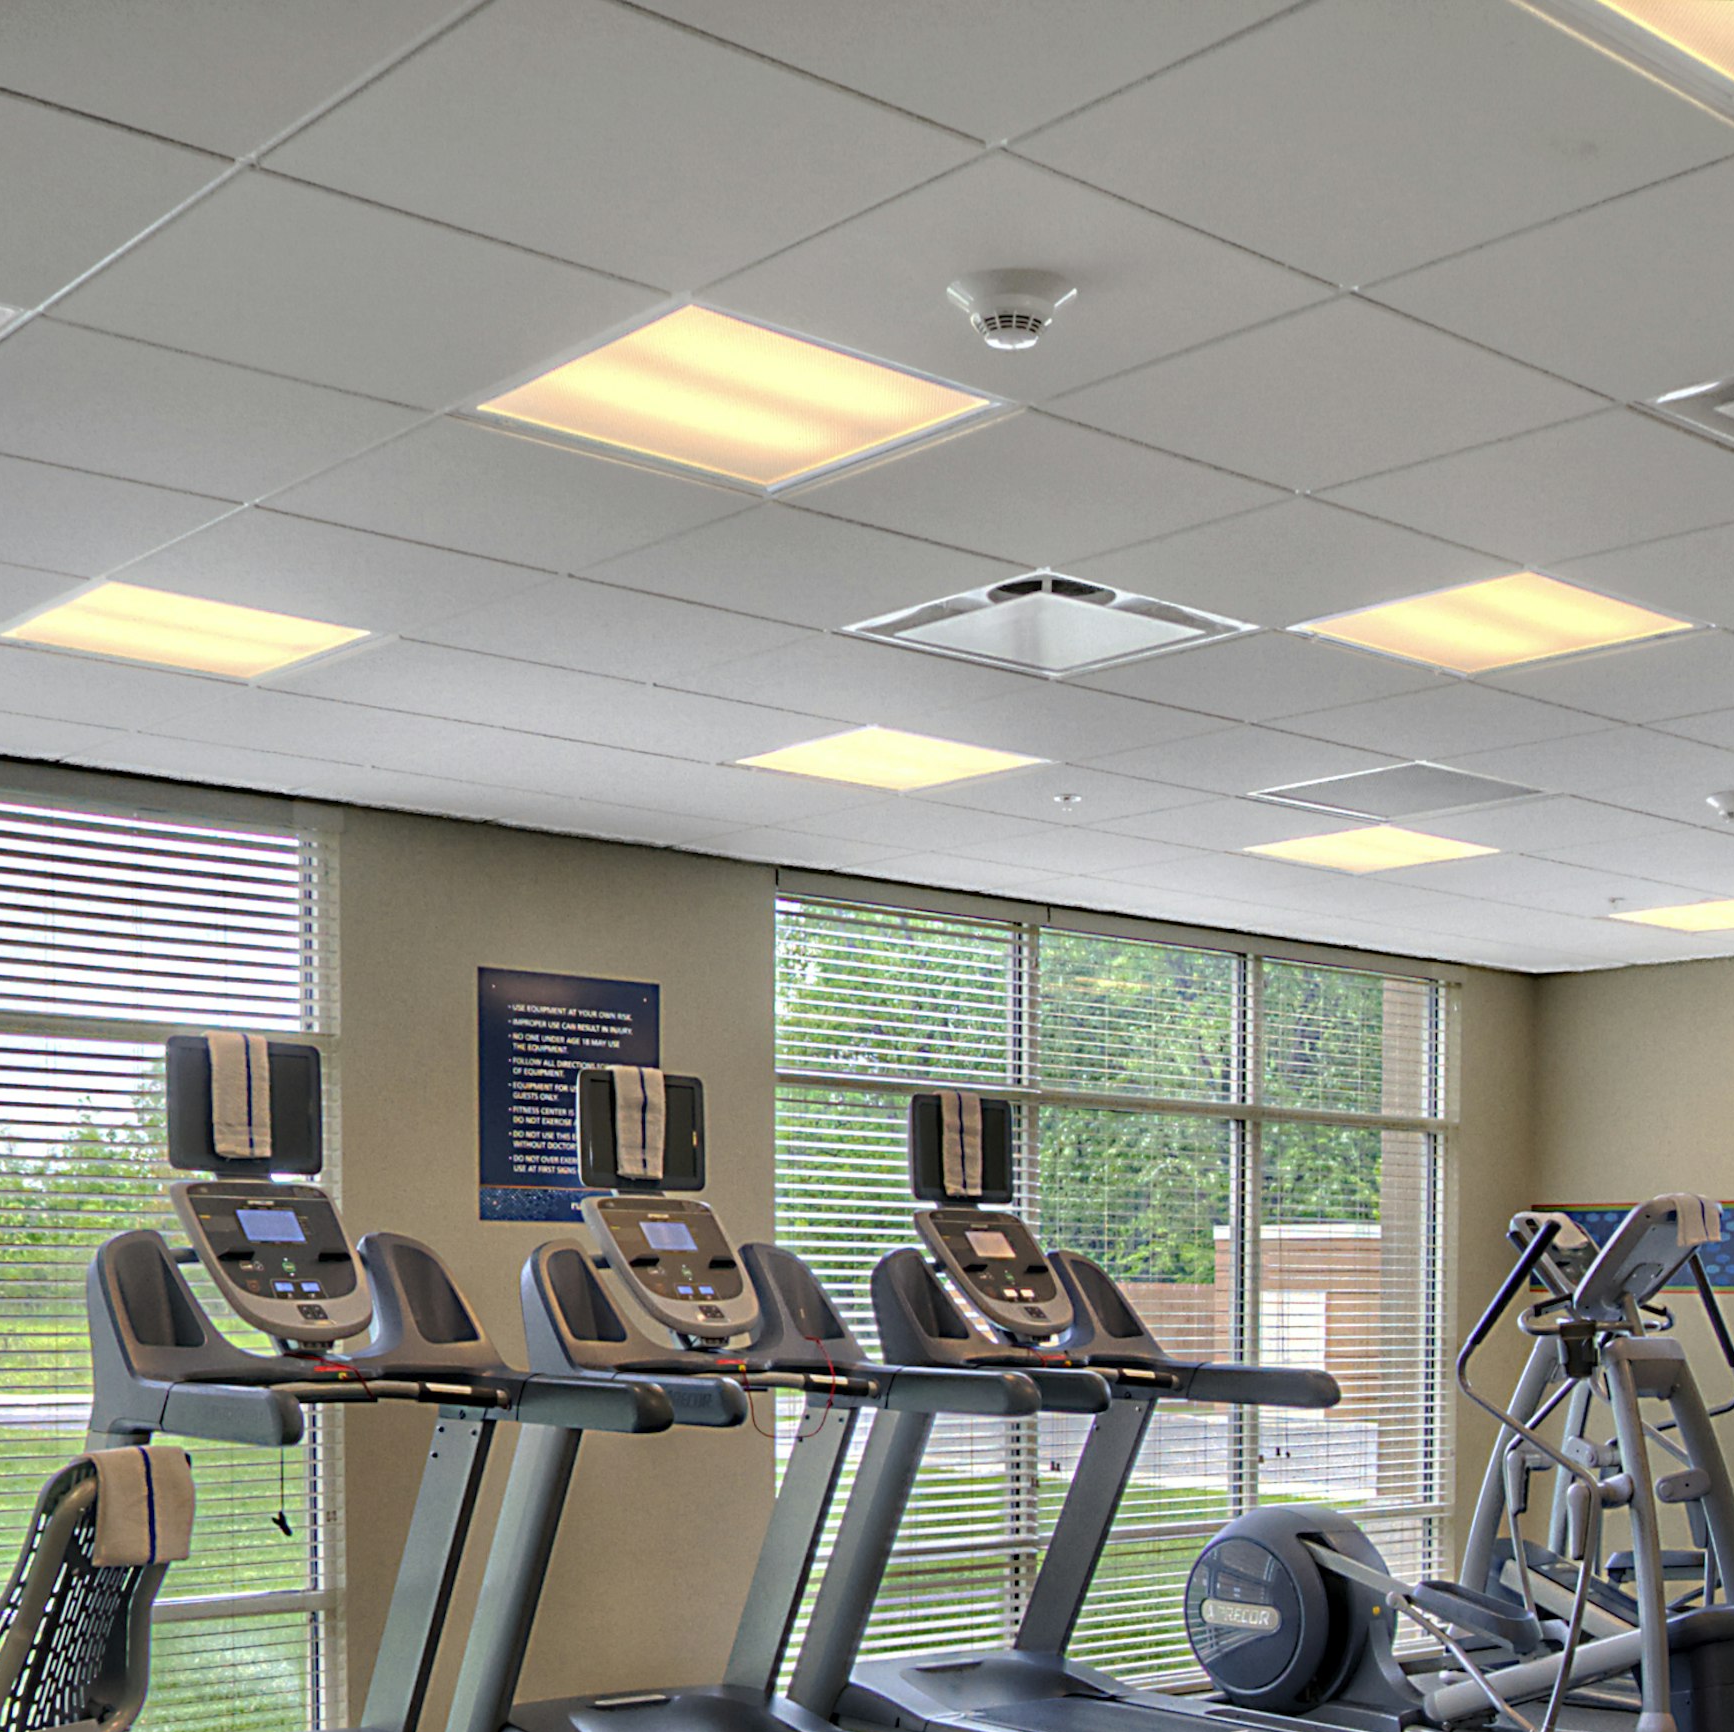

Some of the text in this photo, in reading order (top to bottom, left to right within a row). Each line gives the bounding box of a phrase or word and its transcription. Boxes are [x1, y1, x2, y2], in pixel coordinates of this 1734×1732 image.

[512, 1004, 525, 1012] USE
[527, 1005, 566, 1015] EQUIPMENT
[568, 1008, 577, 1016] AT
[578, 1008, 597, 1018] YOUR
[599, 1011, 616, 1019] OWN
[512, 1018, 546, 1028] IMPROPER
[548, 1020, 560, 1029] USE
[561, 1022, 576, 1030] CAN
[577, 1023, 600, 1032] RESULT
[601, 1025, 608, 1033] IN
[512, 1032, 523, 1040] NO
[525, 1033, 540, 1041] ONE
[541, 1034, 565, 1043] UNDER
[566, 1036, 580, 1045] AGE
[591, 1038, 606, 1047] MAY
[607, 1039, 620, 1048] USE
[512, 1042, 525, 1051] THE
[512, 1057, 542, 1066] FOLLOW
[543, 1059, 555, 1068] ALL
[512, 1066, 522, 1075] OF
[512, 1081, 553, 1091] EQUIPMENT
[554, 1083, 568, 1092] FOR
[512, 1091, 538, 1100] GUESTS
[513, 1105, 539, 1114] FITNESS
[540, 1107, 566, 1116] CENTER
[512, 1115, 524, 1124] DO
[525, 1116, 540, 1125] NOT
[541, 1117, 572, 1126] EXERCISE
[513, 1129, 524, 1138] DO
[525, 1130, 540, 1139] NOT
[541, 1131, 554, 1140] USE
[556, 1132, 570, 1140] THIS
[513, 1140, 577, 1150] WITHOUT DOCTOR
[513, 1154, 524, 1162] DO
[525, 1155, 540, 1163] NOT
[540, 1155, 559, 1164] OVER
[513, 1165, 577, 1175] USE AT FIRST SIGNS
